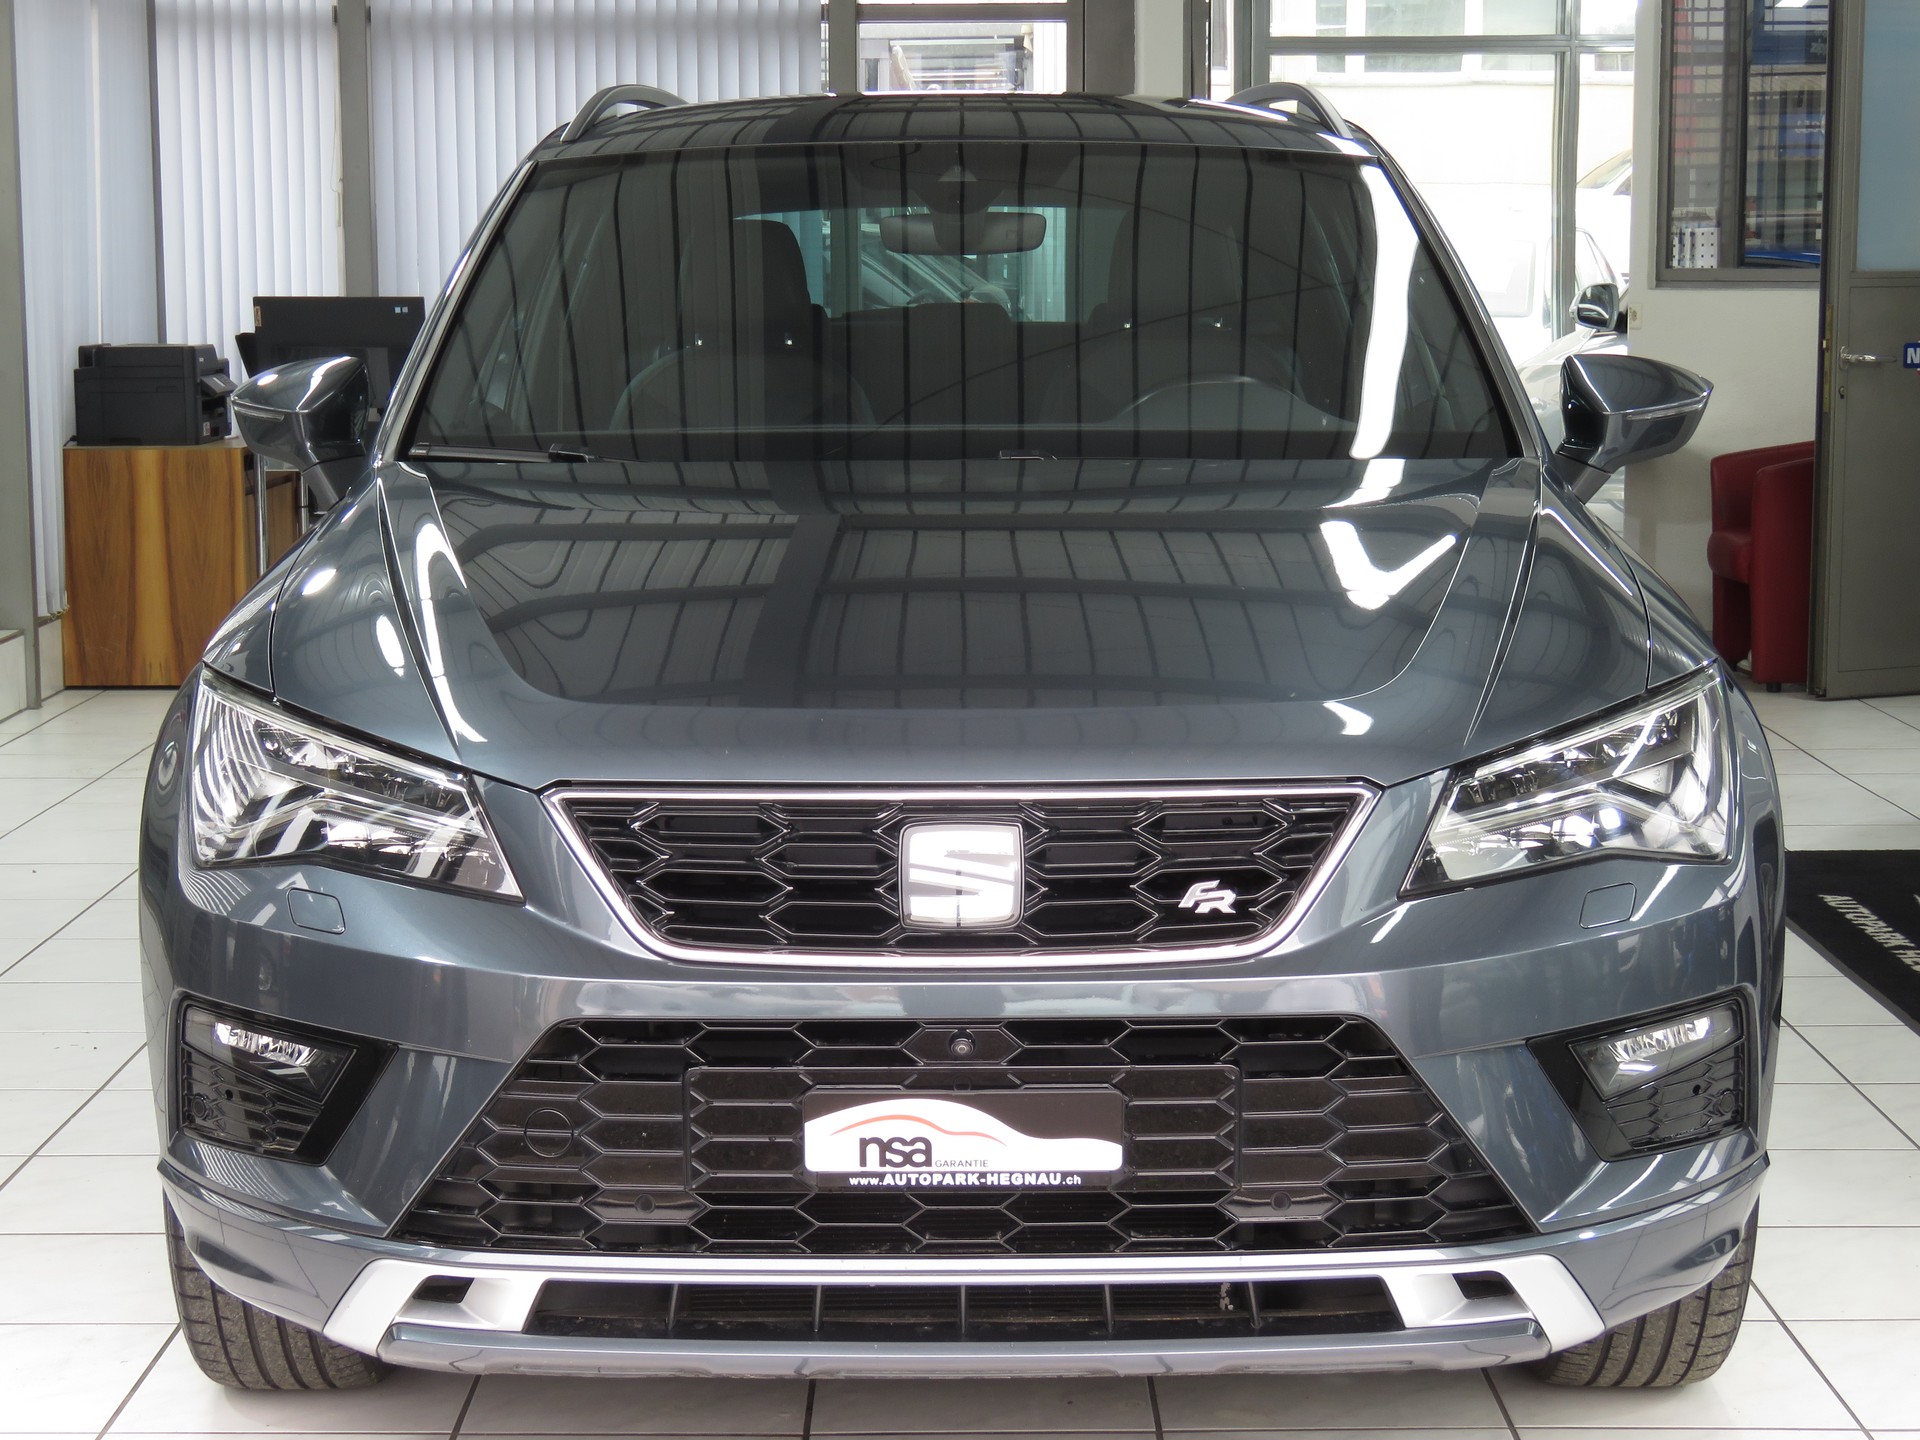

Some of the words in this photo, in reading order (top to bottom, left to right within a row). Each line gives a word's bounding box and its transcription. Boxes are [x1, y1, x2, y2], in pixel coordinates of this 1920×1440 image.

[1178, 880, 1236, 914] FR
[1817, 894, 1915, 948] AUTOPARK
[859, 1136, 933, 1168] nsa
[935, 1159, 989, 1168] GARANTIE
[848, 1172, 1082, 1186] www.AUTOPARK-HEGNAU.ch
